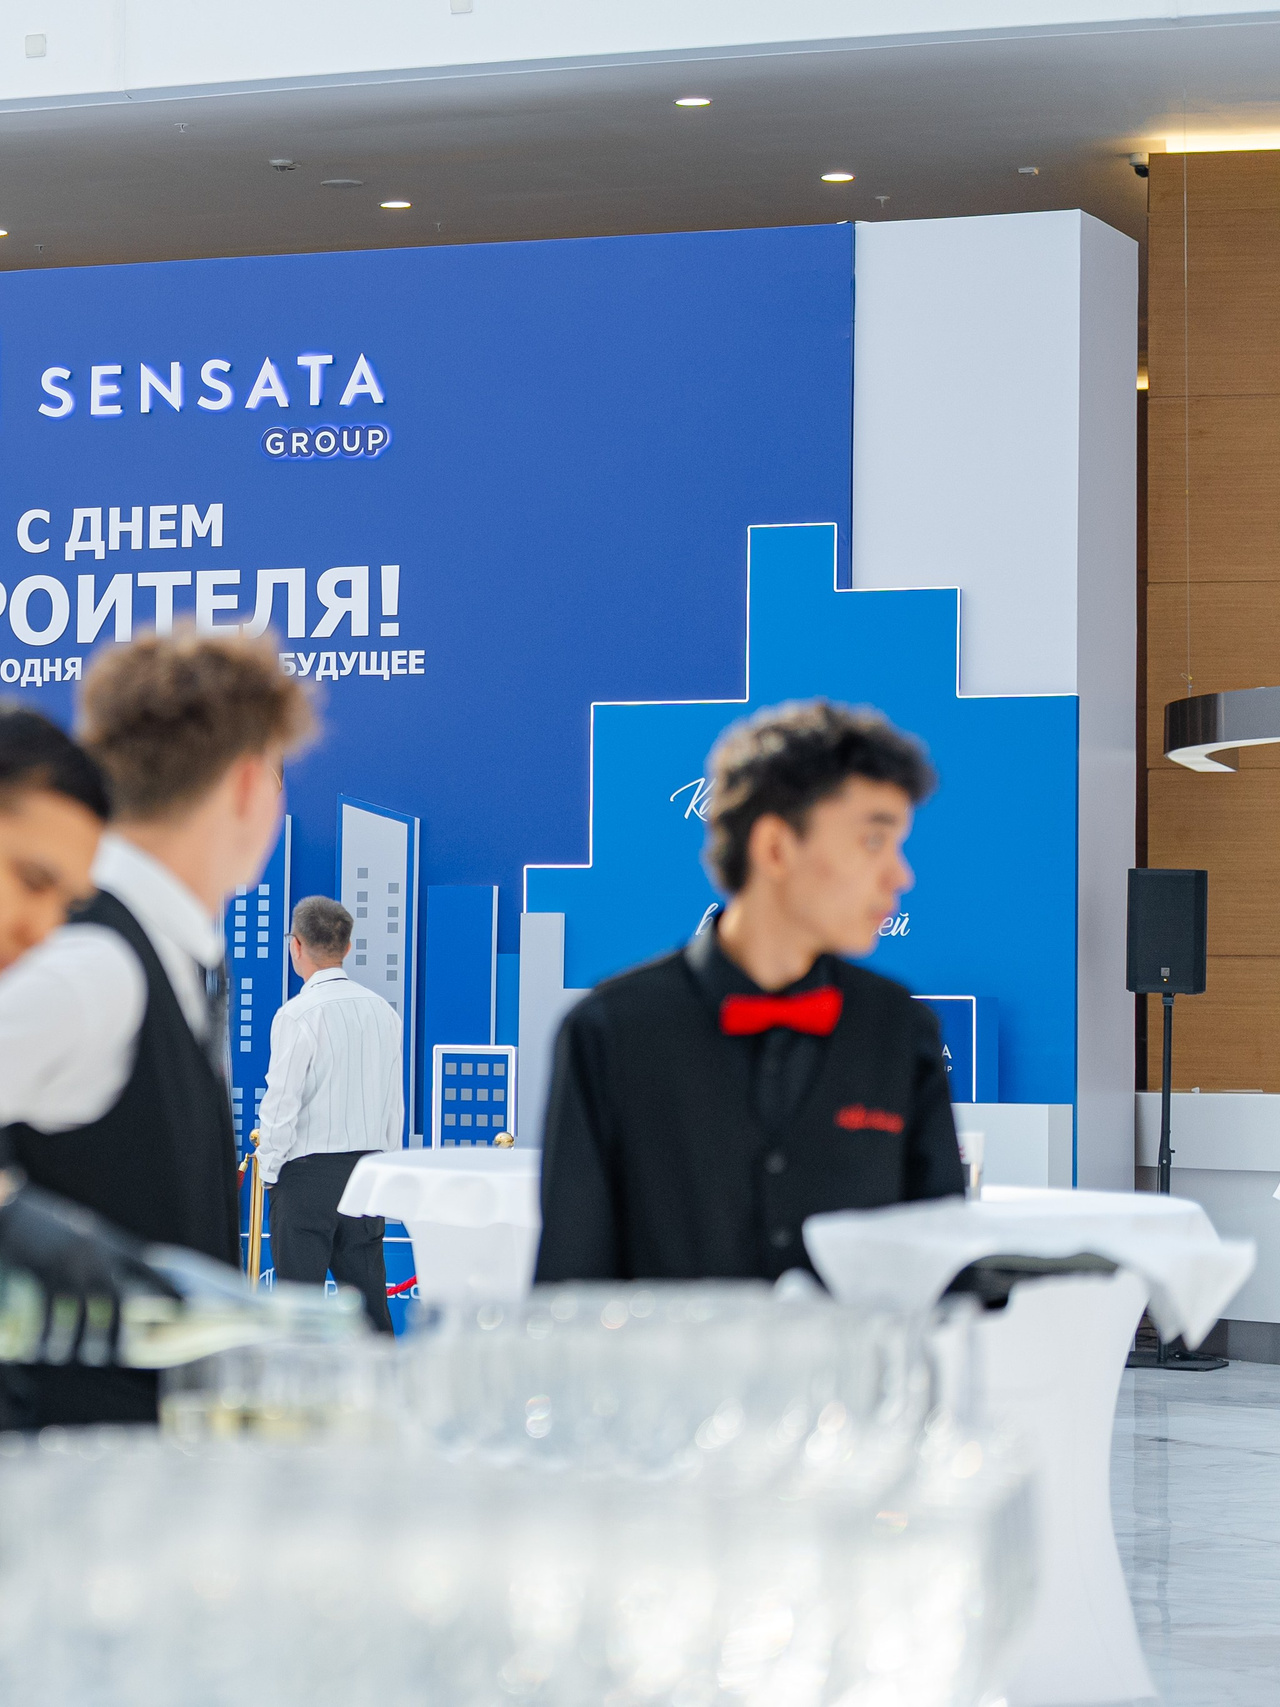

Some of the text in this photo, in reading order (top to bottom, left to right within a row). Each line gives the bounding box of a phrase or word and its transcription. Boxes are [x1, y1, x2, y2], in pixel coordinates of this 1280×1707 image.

[38, 353, 384, 418] SENSATA
[265, 428, 386, 457] GROUP
[17, 503, 224, 561] С ДНЕМ
[278, 649, 426, 682] БУДУЩЕЕ
